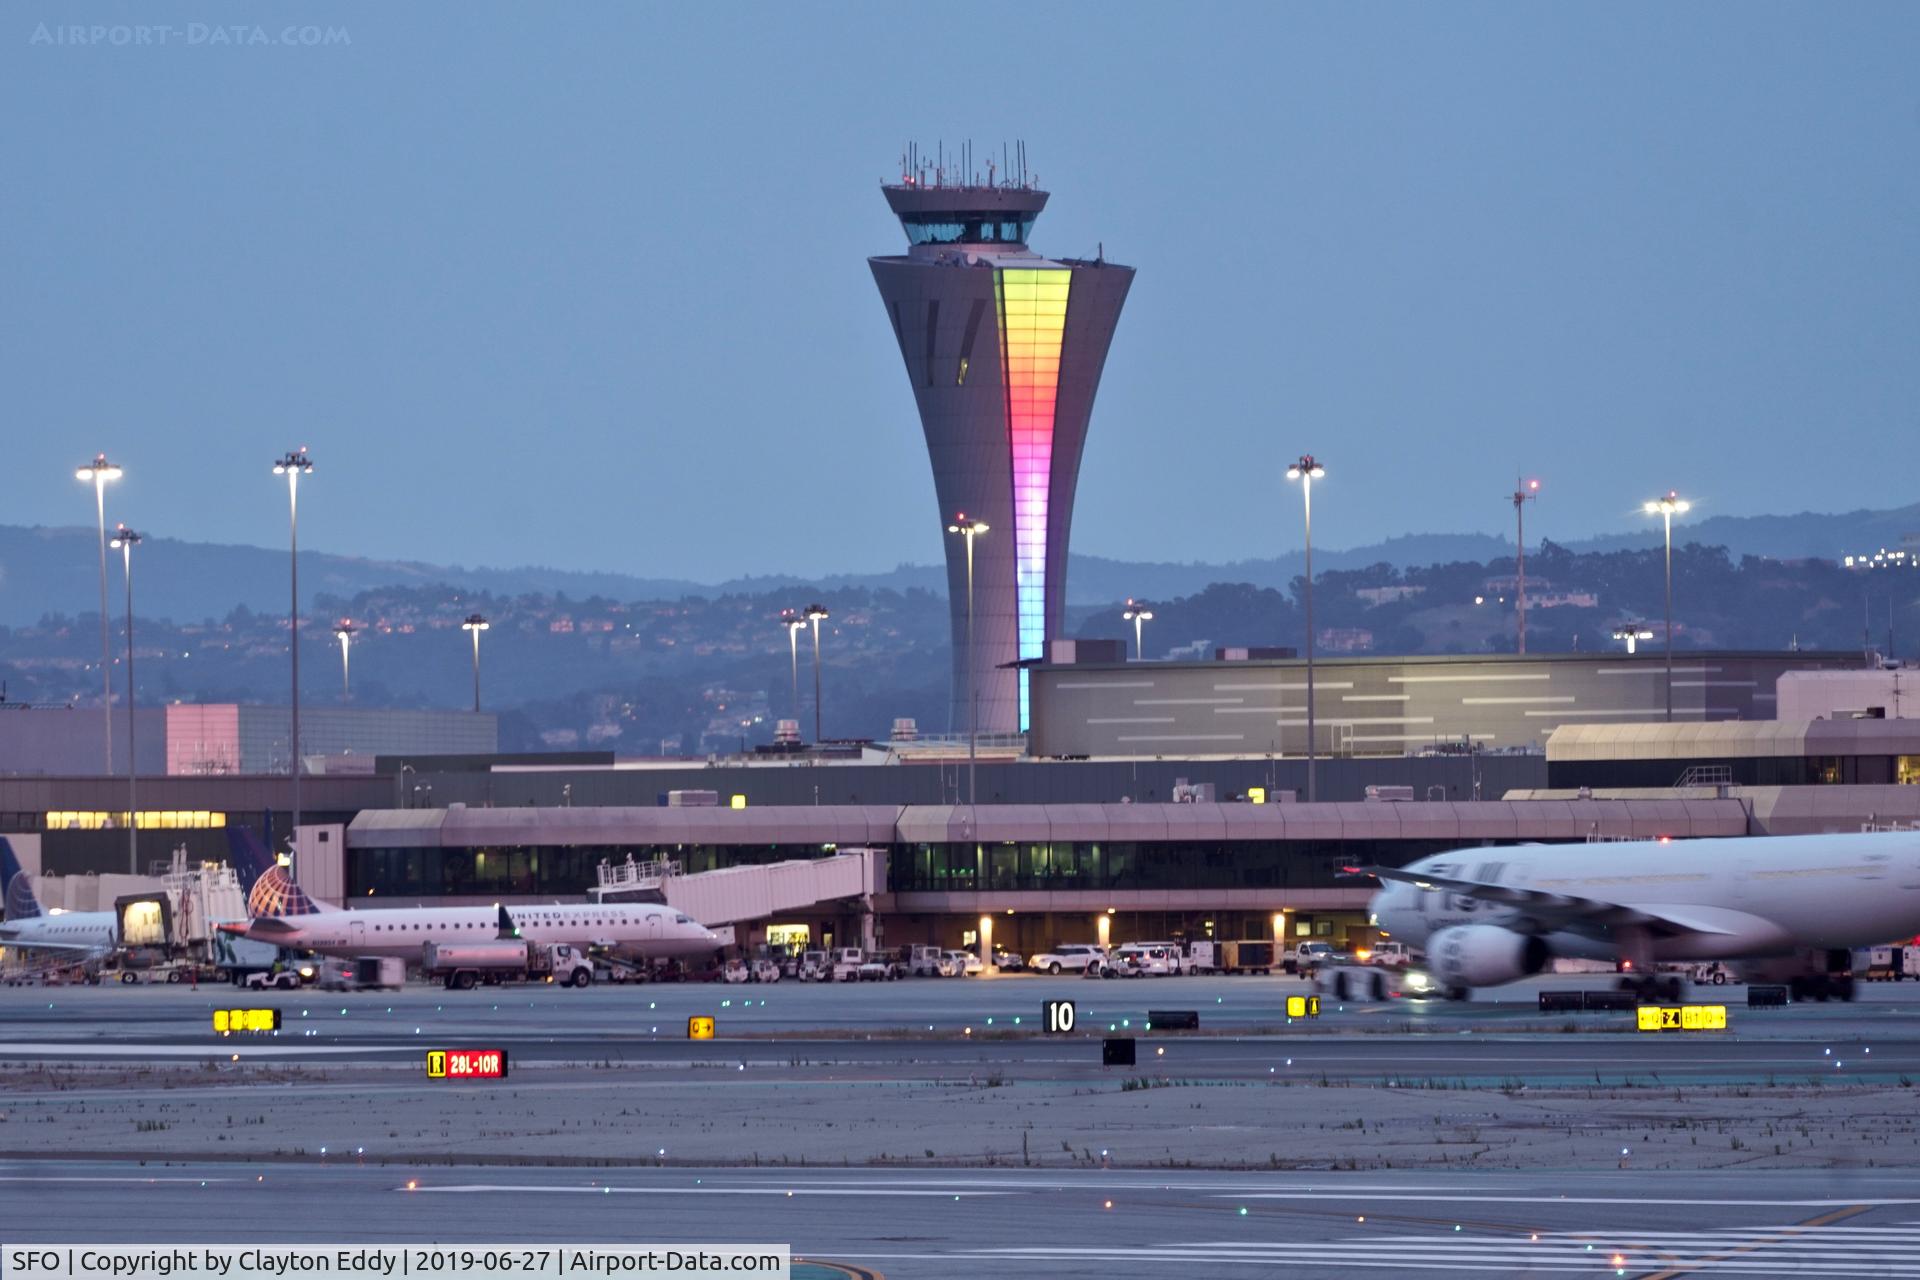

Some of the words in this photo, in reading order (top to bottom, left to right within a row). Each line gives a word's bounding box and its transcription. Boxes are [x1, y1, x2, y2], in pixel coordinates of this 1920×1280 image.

[1050, 1002, 1074, 1032] 10
[433, 1055, 441, 1074] R
[451, 1055, 499, 1074] 28L-10R
